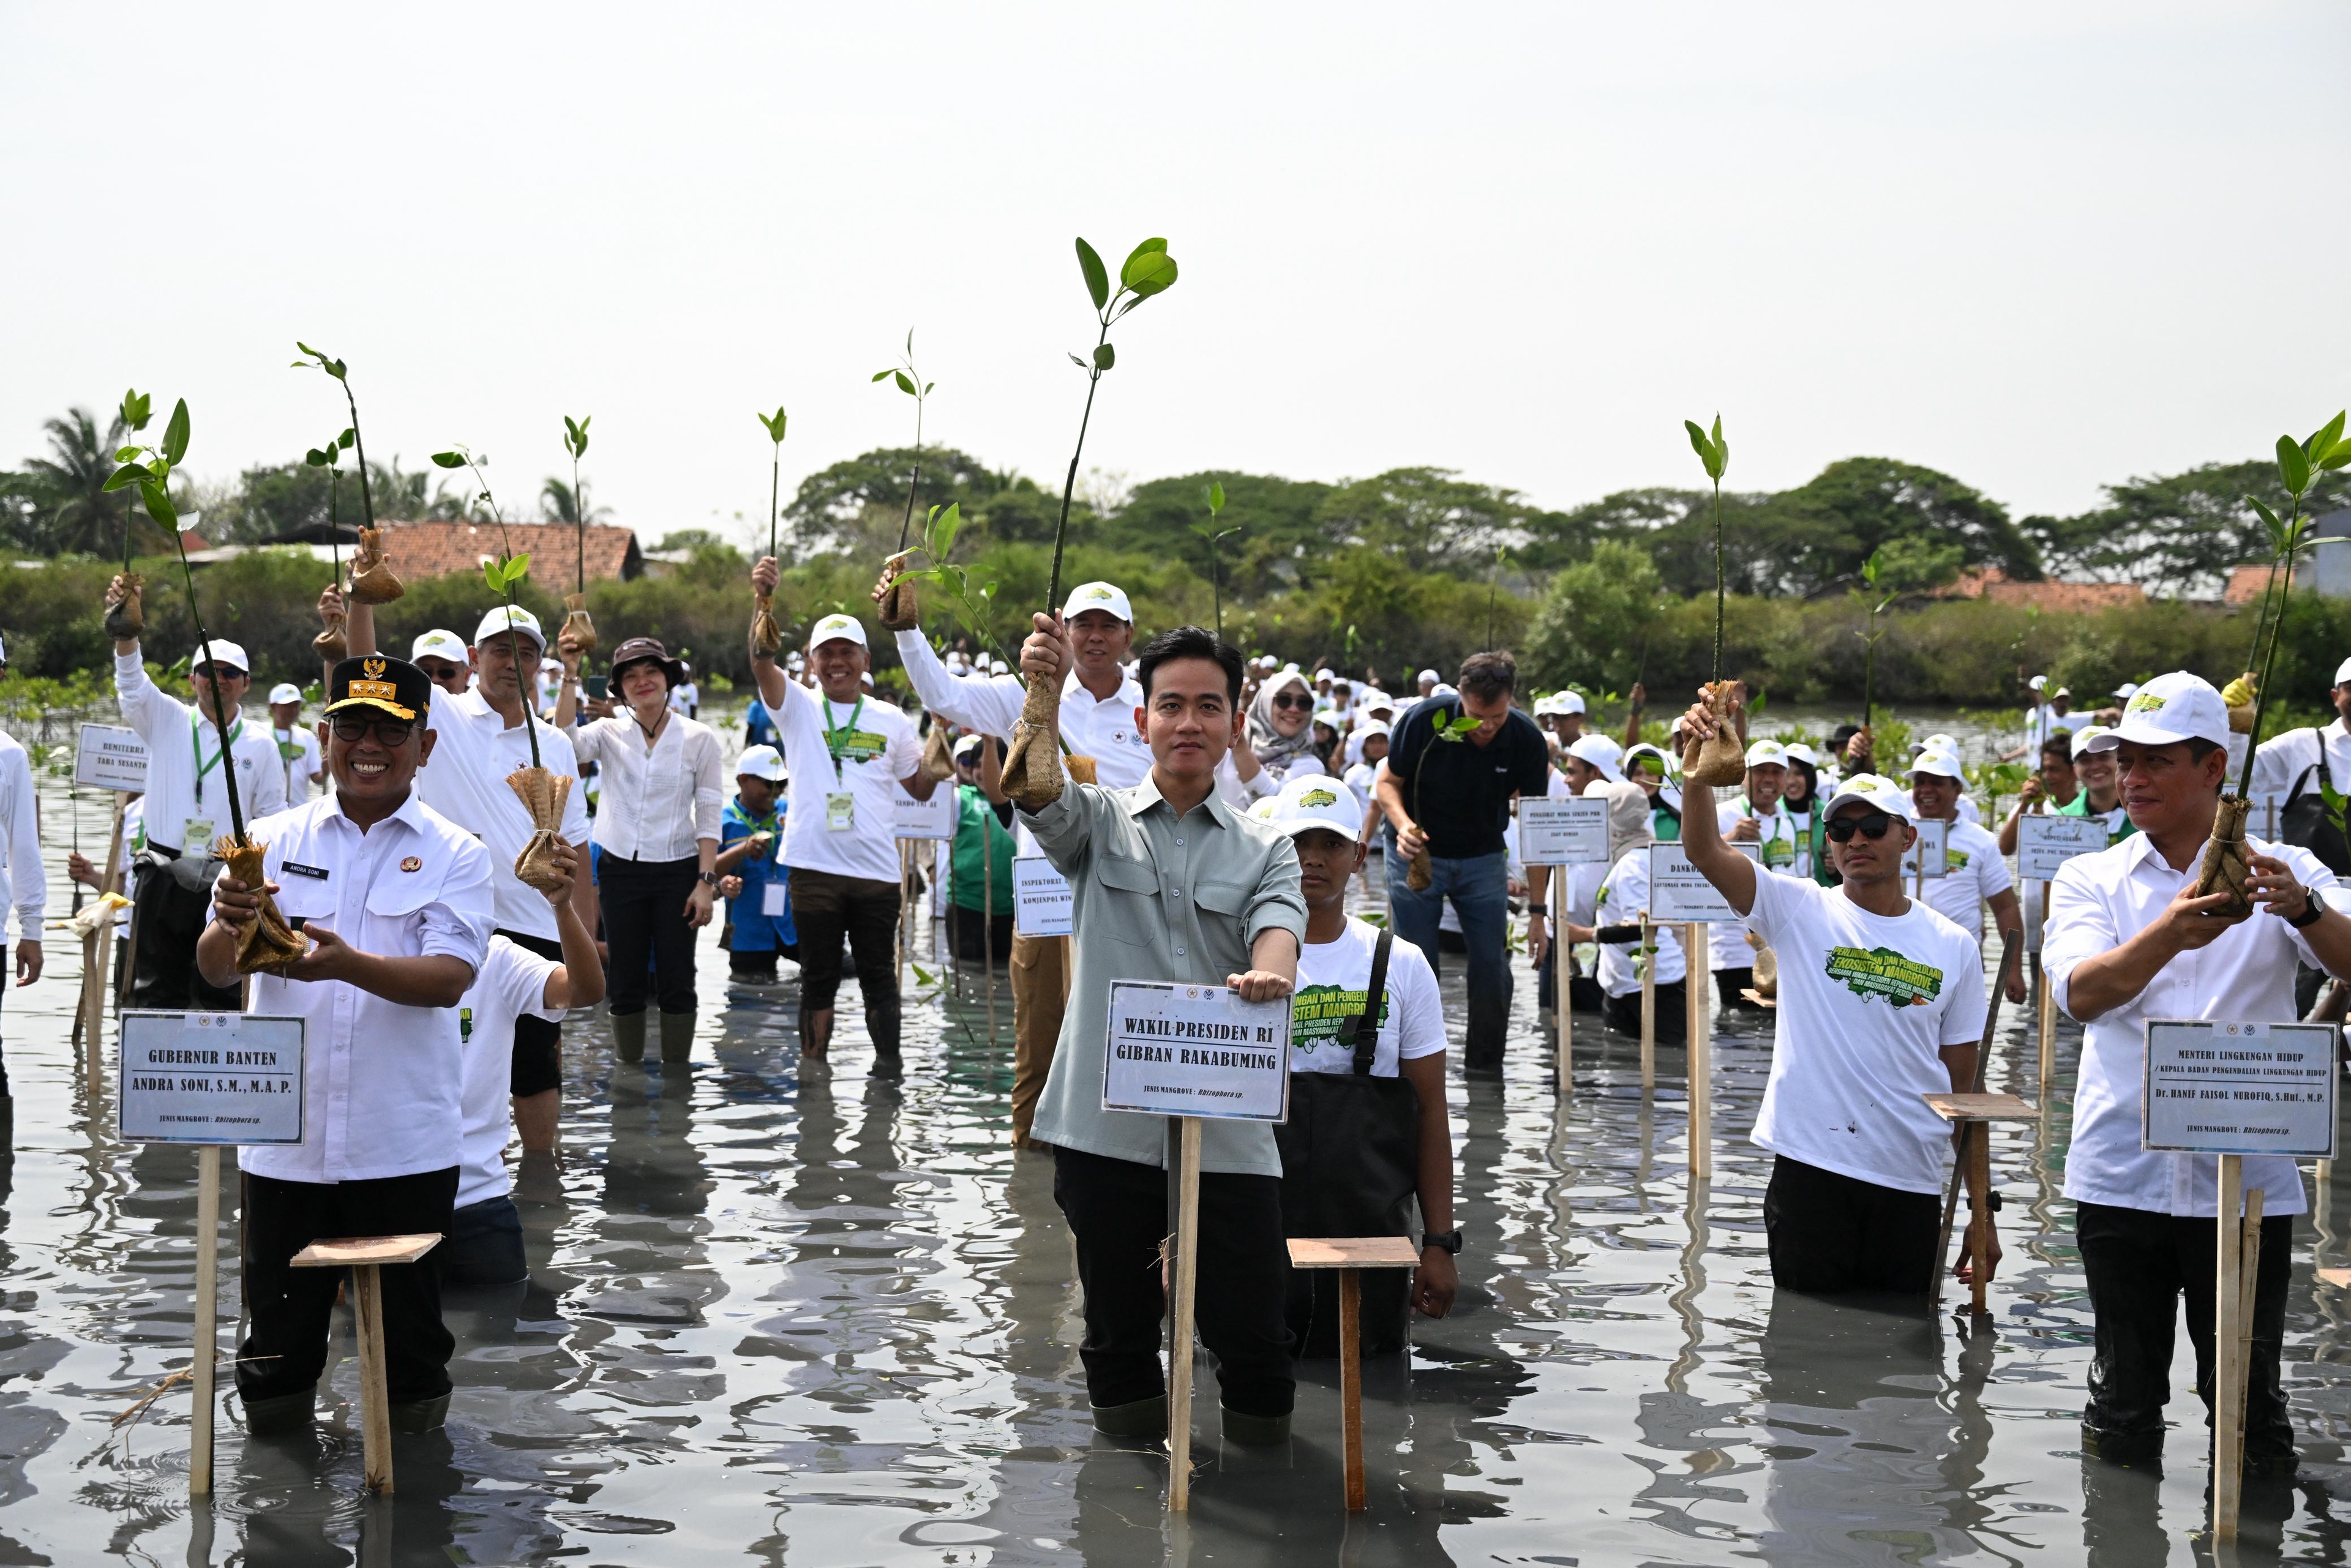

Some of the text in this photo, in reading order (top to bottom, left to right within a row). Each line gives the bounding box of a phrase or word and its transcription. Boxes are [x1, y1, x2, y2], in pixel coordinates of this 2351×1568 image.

[103, 743, 144, 754] BUMITERRA
[118, 760, 147, 769] SUSANTO
[1833, 947, 1942, 980] PERLINDUNGAN DAN PENGELOLAAN
[1834, 957, 1932, 991] EKOSISTEM MANGROVE
[1828, 967, 1935, 1000] BERSAMA WAKIL PRESIDEN REPUBLIK INDONESIA
[1864, 980, 1896, 993] MASYARAKAT
[1895, 988, 1914, 999] PESISIR
[1320, 992, 1336, 1003] DAN
[1305, 1018, 1331, 1027] PRESIDEN
[1125, 1018, 1273, 1043] WAKIL PRESIDEN RI
[1303, 1026, 1339, 1036] MASYARAKAT
[149, 1049, 277, 1065] GUBERNUR BANTEN
[1117, 1045, 1277, 1070] GIBRAN RAKABUMING
[2178, 1050, 2304, 1062] MENTERI LINGKUNGAN HIDUP
[2213, 1067, 2260, 1075] PENGENDALIAN
[132, 1078, 174, 1090] ANDRA
[181, 1079, 213, 1093] SONI,
[217, 1079, 247, 1094] S.M.,
[1198, 1089, 1234, 1098] Rhizophora
[2156, 1089, 2324, 1103] Dr. HANIF FAISOL NUROFIQ, S.Hut., M.P.
[2243, 1127, 2280, 1135] Rhizophora
